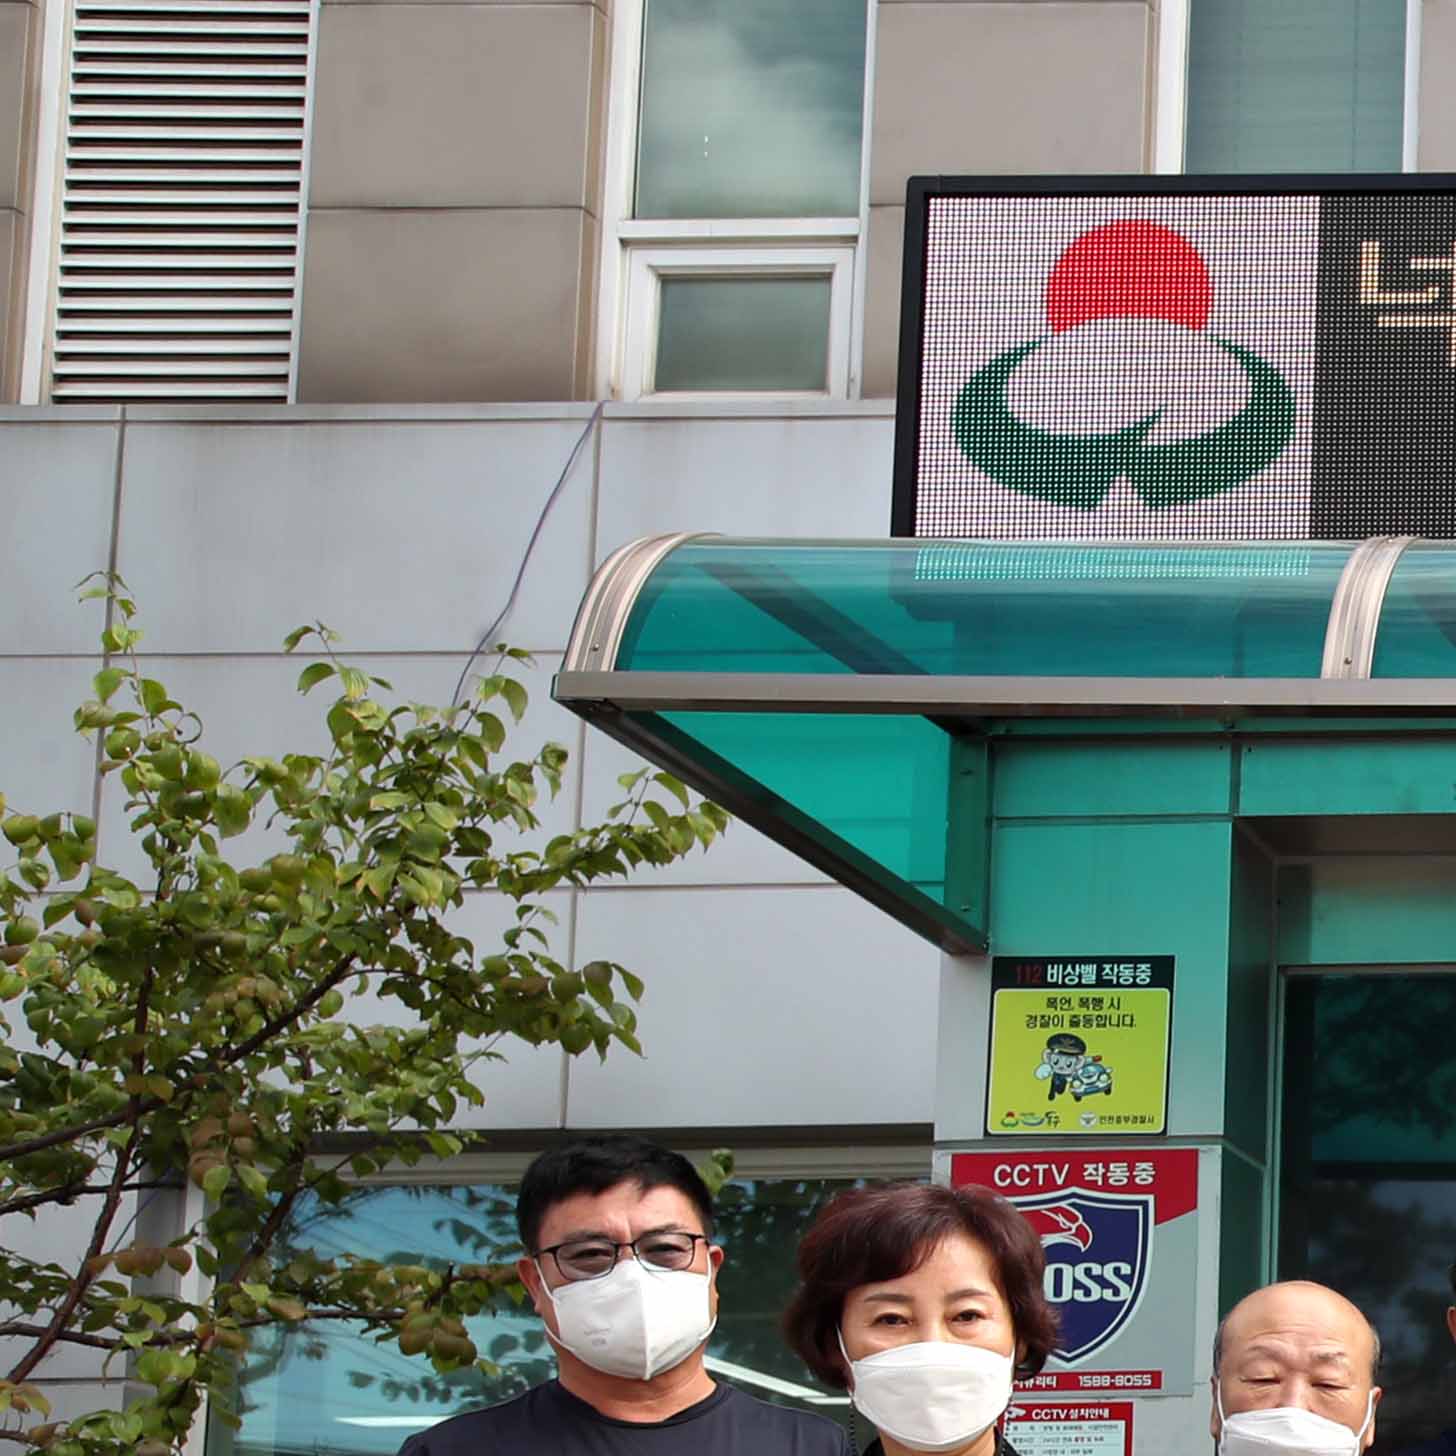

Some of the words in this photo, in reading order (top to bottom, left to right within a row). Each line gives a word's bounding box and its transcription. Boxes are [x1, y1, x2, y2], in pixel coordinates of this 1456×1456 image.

[1046, 964, 1097, 985] 비상벨
[1101, 963, 1152, 985] 작동중
[1108, 997, 1121, 1011] 시
[1026, 1014, 1064, 1029] 경찰이
[994, 1164, 1070, 1187] CCTV
[1082, 1162, 1156, 1186] 작동중
[1043, 1262, 1132, 1303] OSS
[1078, 1375, 1152, 1388] 1588-8055
